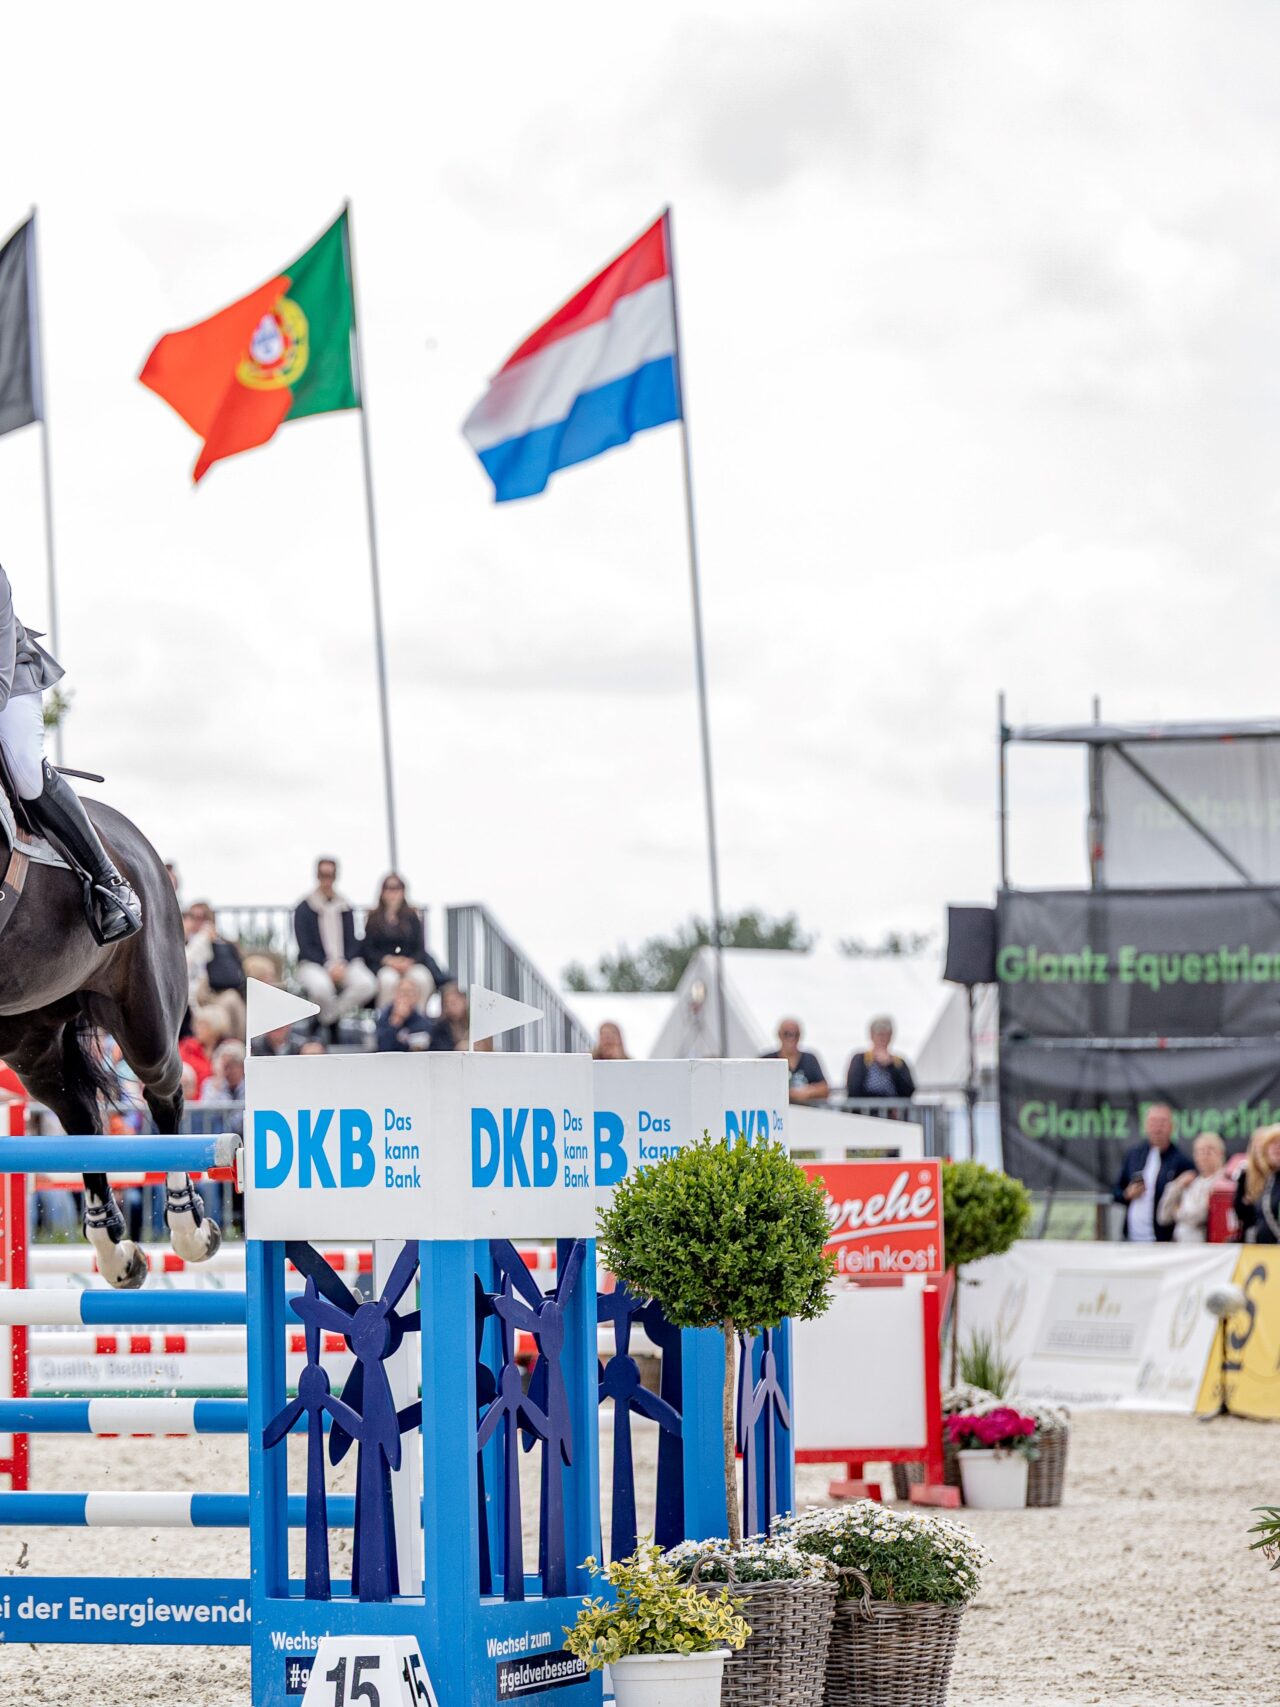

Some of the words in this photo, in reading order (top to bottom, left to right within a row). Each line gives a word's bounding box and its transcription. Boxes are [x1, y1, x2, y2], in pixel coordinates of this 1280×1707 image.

[996, 944, 1109, 984] Glantz
[384, 1108, 412, 1131] Das
[563, 1109, 583, 1132] Das
[638, 1110, 671, 1132] Das
[772, 1109, 783, 1131] Das
[1019, 1101, 1129, 1139] Glantz
[253, 1108, 376, 1189] DKB
[384, 1137, 420, 1160] kann
[470, 1107, 559, 1188] DKB
[563, 1137, 589, 1160] kann
[384, 1166, 421, 1189] Bank
[564, 1165, 590, 1189] Bank
[821, 1171, 936, 1233] rehe
[837, 1244, 937, 1273] feinkost
[17, 1595, 62, 1620] der
[271, 1630, 329, 1650] Wechs
[486, 1630, 529, 1658] Wechsel
[530, 1631, 552, 1649] zum
[326, 1655, 380, 1707] 15
[402, 1653, 433, 1707] 15
